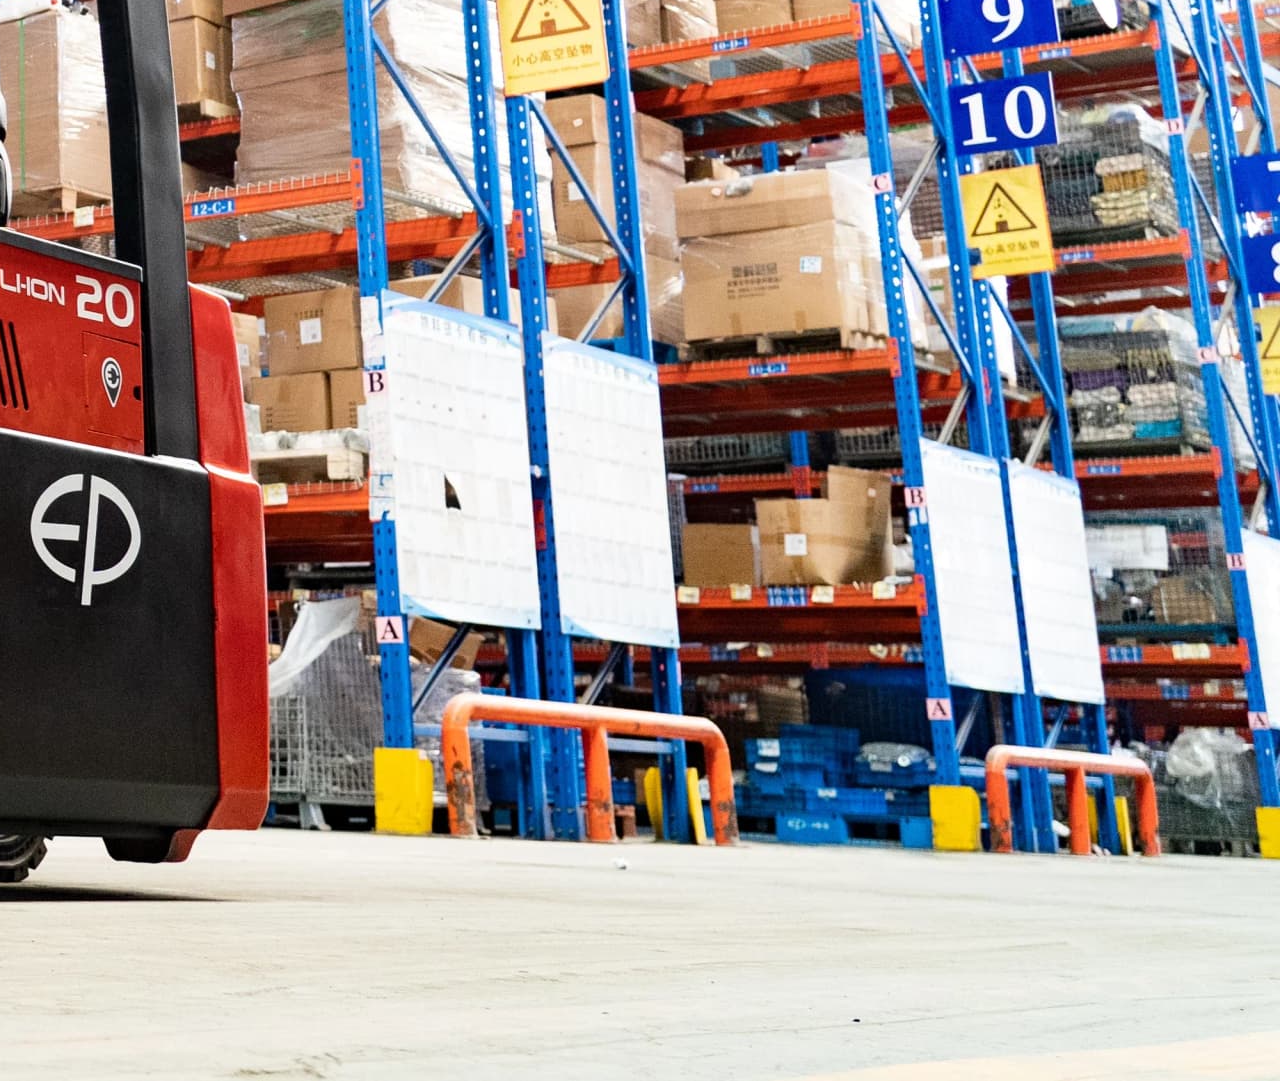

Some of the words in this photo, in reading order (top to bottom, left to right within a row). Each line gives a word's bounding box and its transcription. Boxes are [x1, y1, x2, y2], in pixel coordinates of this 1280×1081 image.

[959, 85, 1047, 146] 10
[873, 174, 888, 191] C
[193, 199, 234, 216] 12-C-1
[75, 274, 135, 328] 20
[368, 371, 384, 393] B
[910, 489, 924, 505] B
[30, 473, 141, 606] EP
[380, 618, 400, 641] A
[932, 700, 947, 716] A
[1252, 714, 1266, 727] A
